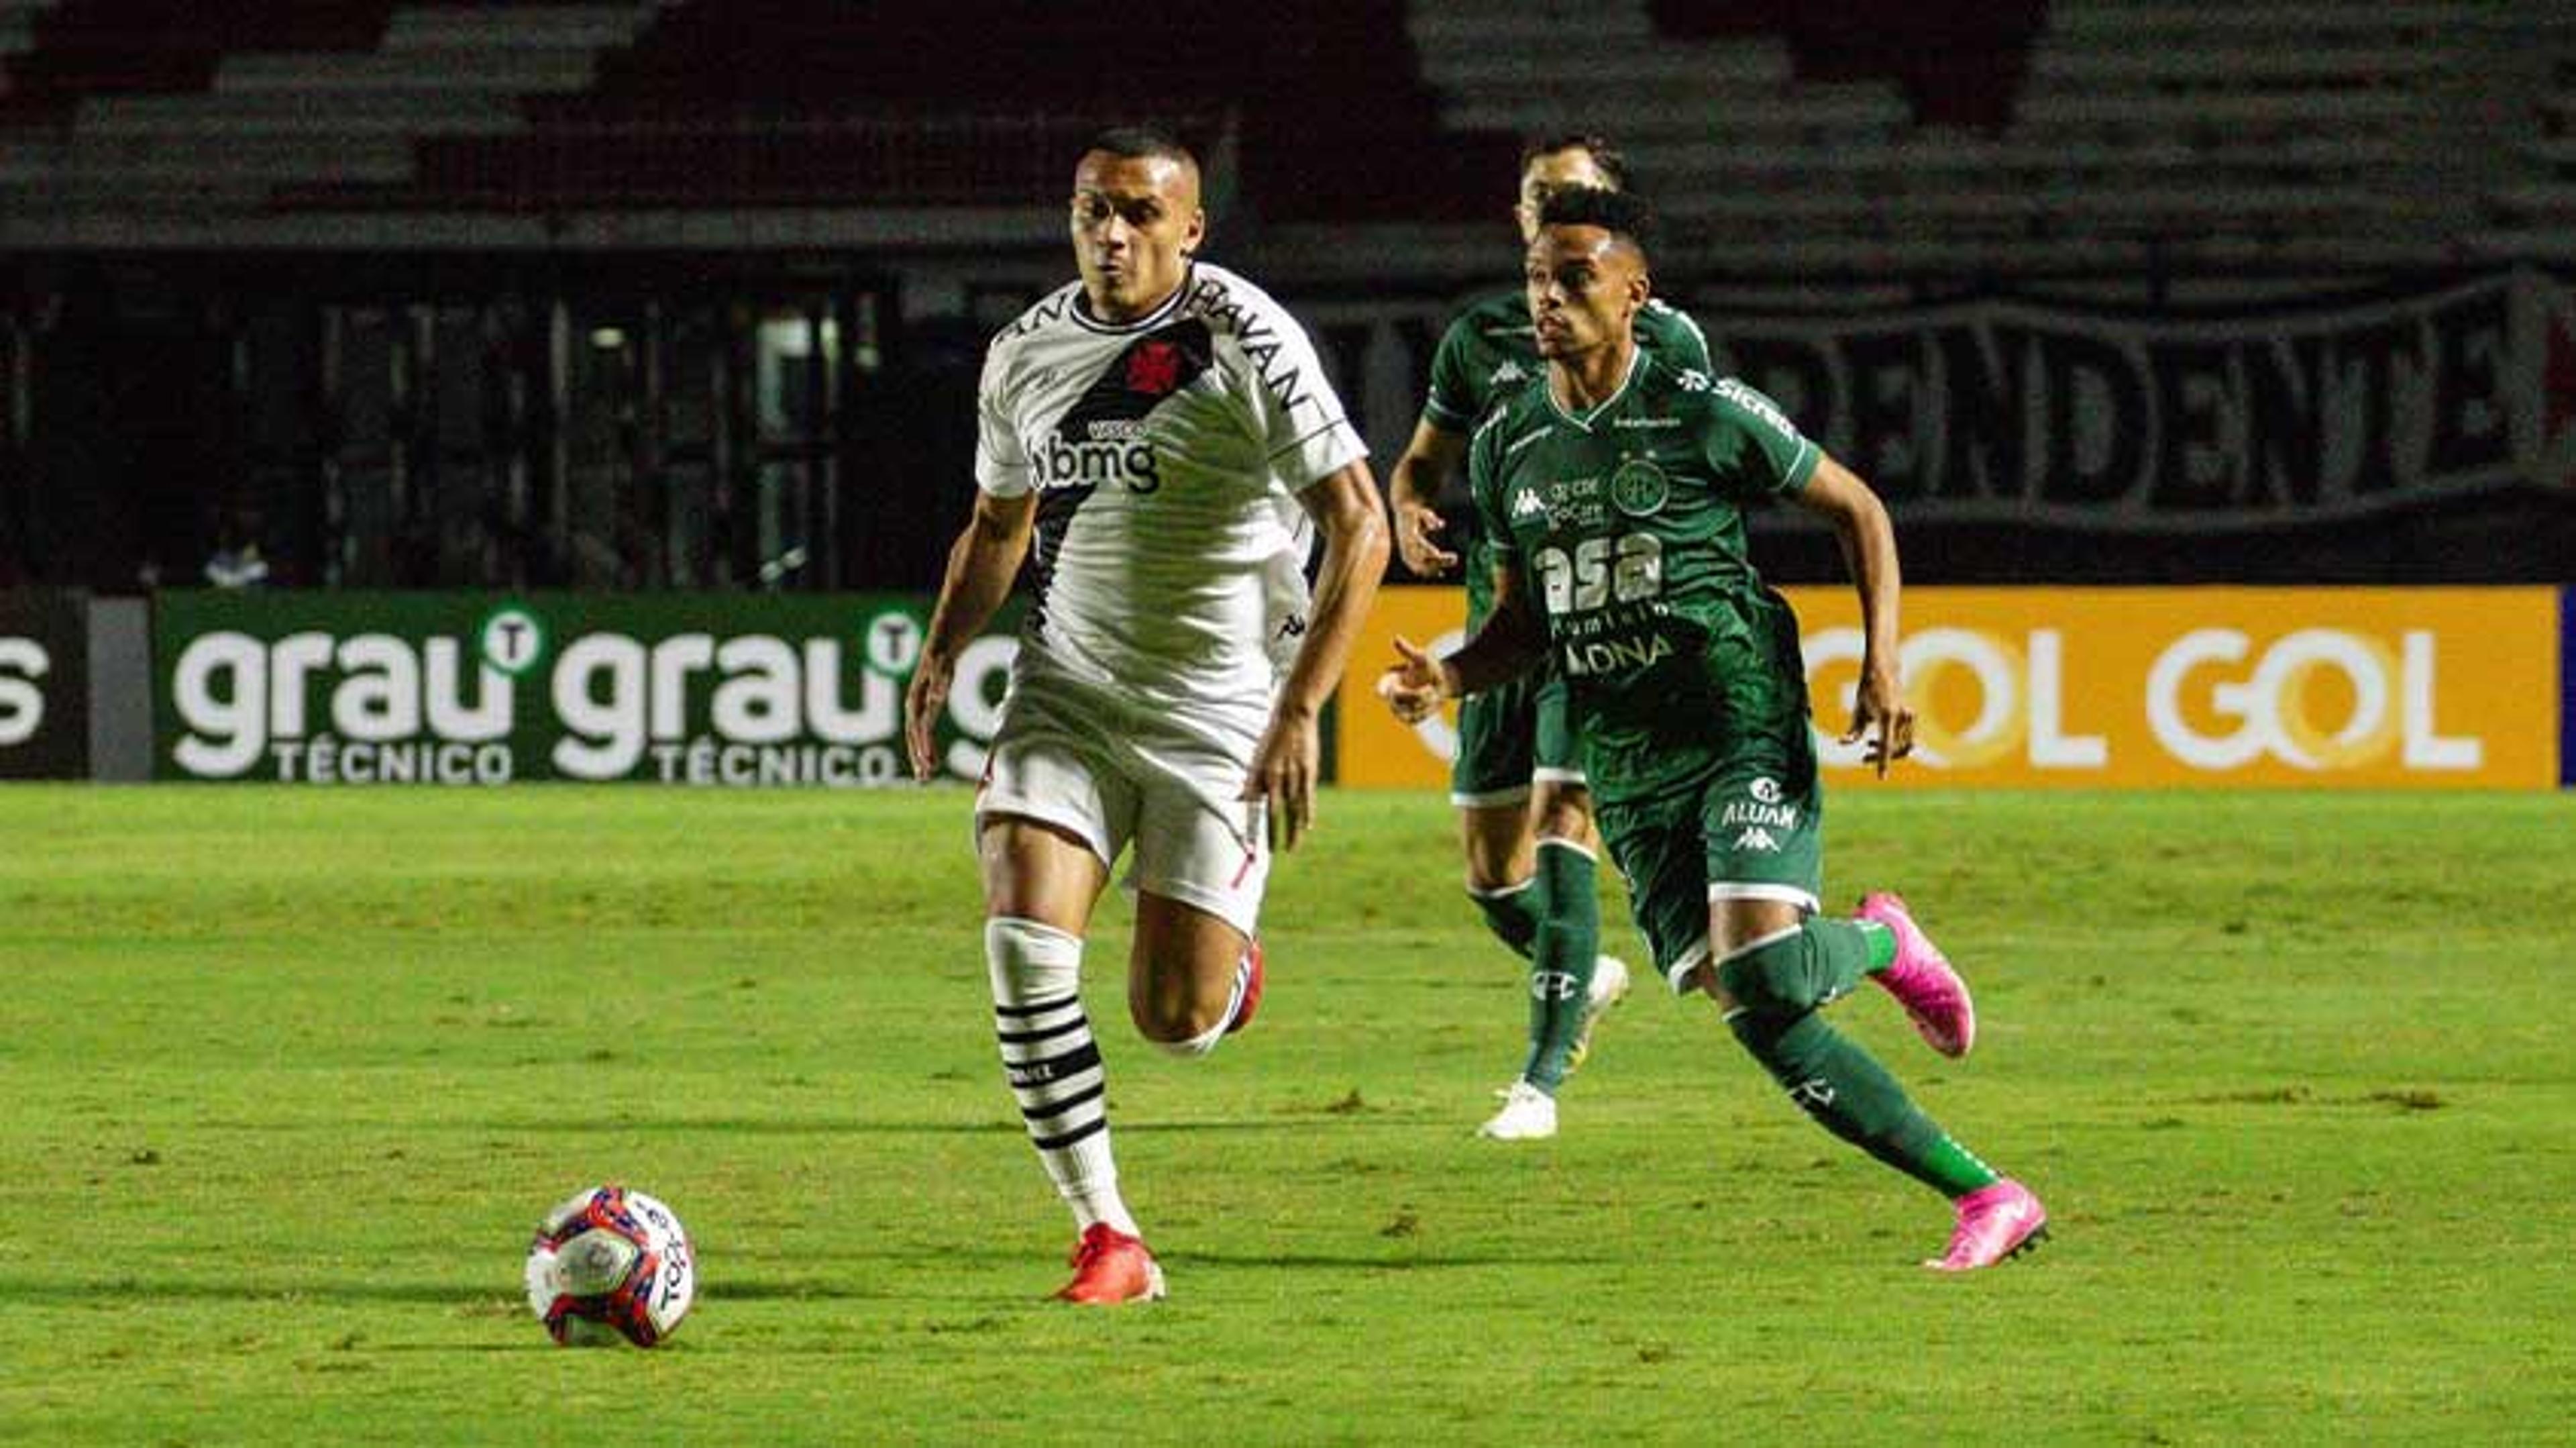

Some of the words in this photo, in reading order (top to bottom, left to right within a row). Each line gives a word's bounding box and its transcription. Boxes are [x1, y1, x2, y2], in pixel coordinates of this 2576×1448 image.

[1046, 433, 1160, 494] bmg
[173, 631, 513, 776] grau
[272, 735, 512, 783] TÉCNICO
[552, 633, 899, 779] grau
[2147, 627, 2481, 769] GOL
